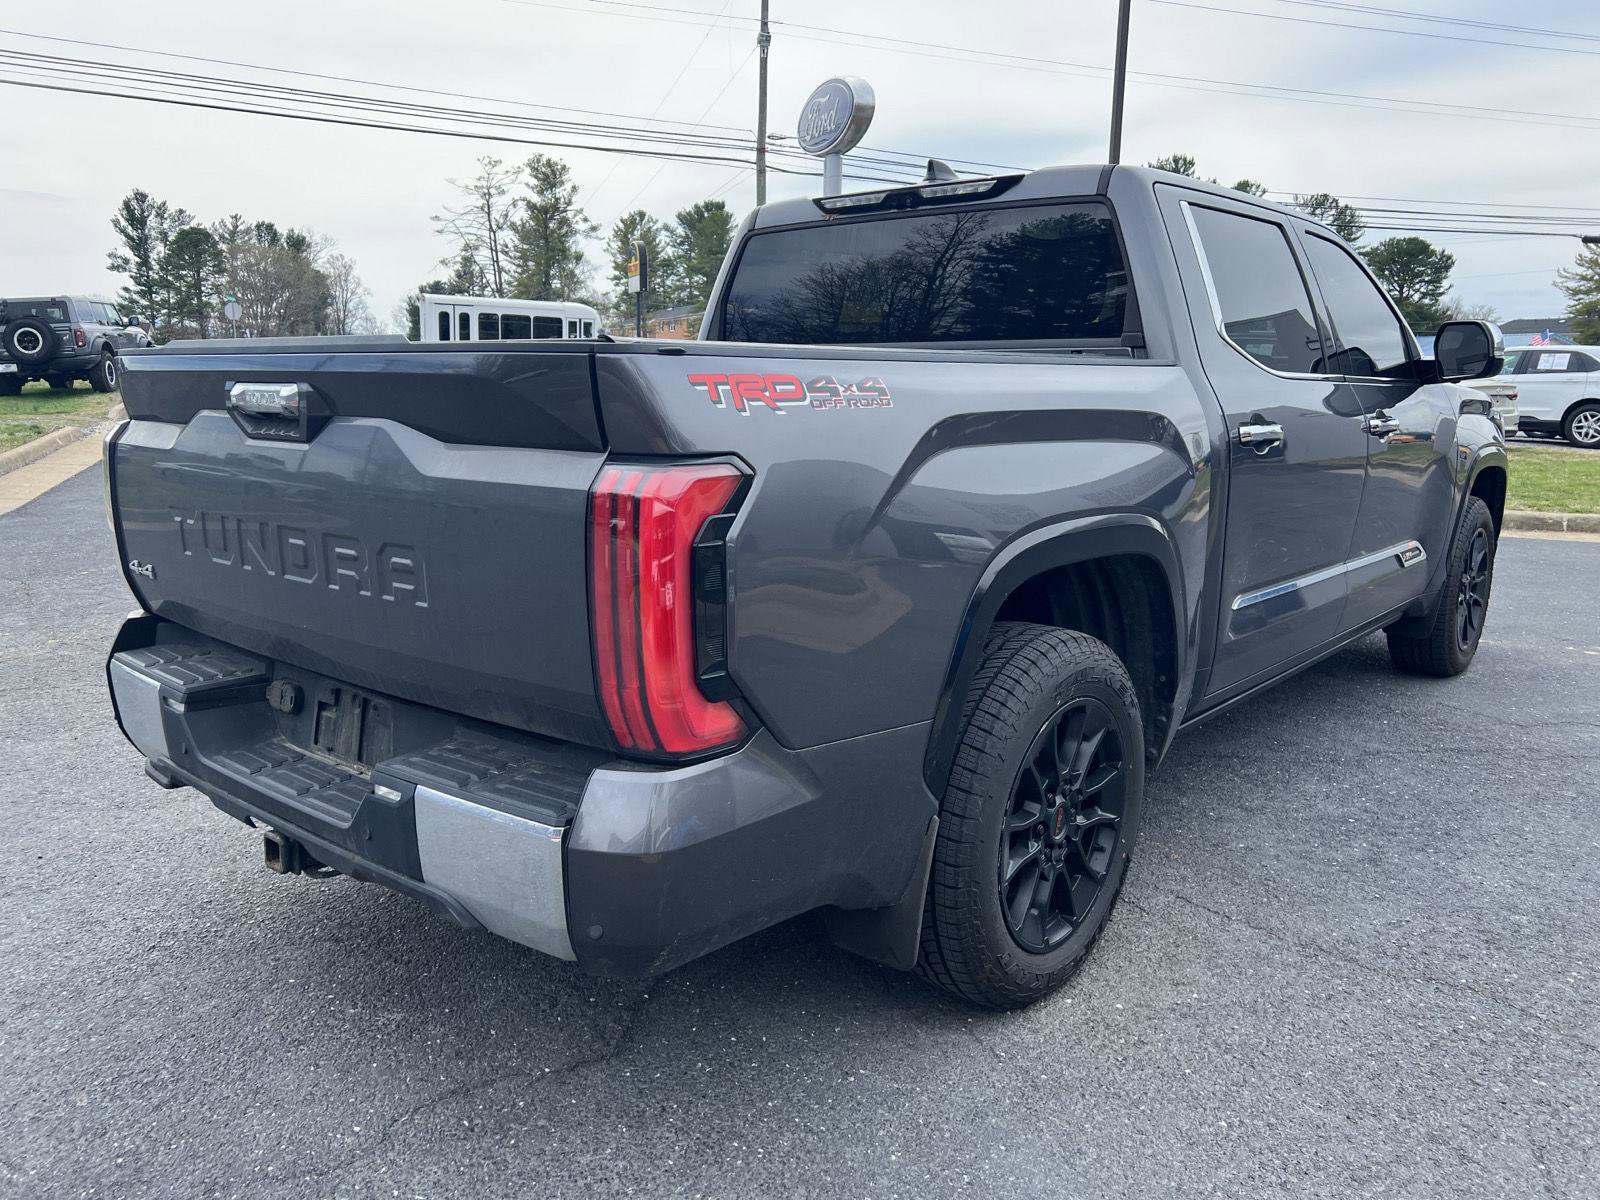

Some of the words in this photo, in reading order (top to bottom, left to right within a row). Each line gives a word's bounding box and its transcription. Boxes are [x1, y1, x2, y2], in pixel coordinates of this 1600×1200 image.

[805, 94, 840, 141] Ford
[687, 373, 808, 416] TRD
[811, 398, 846, 410] OFF
[847, 398, 893, 409] ROAD
[169, 506, 428, 608] TUNDRA
